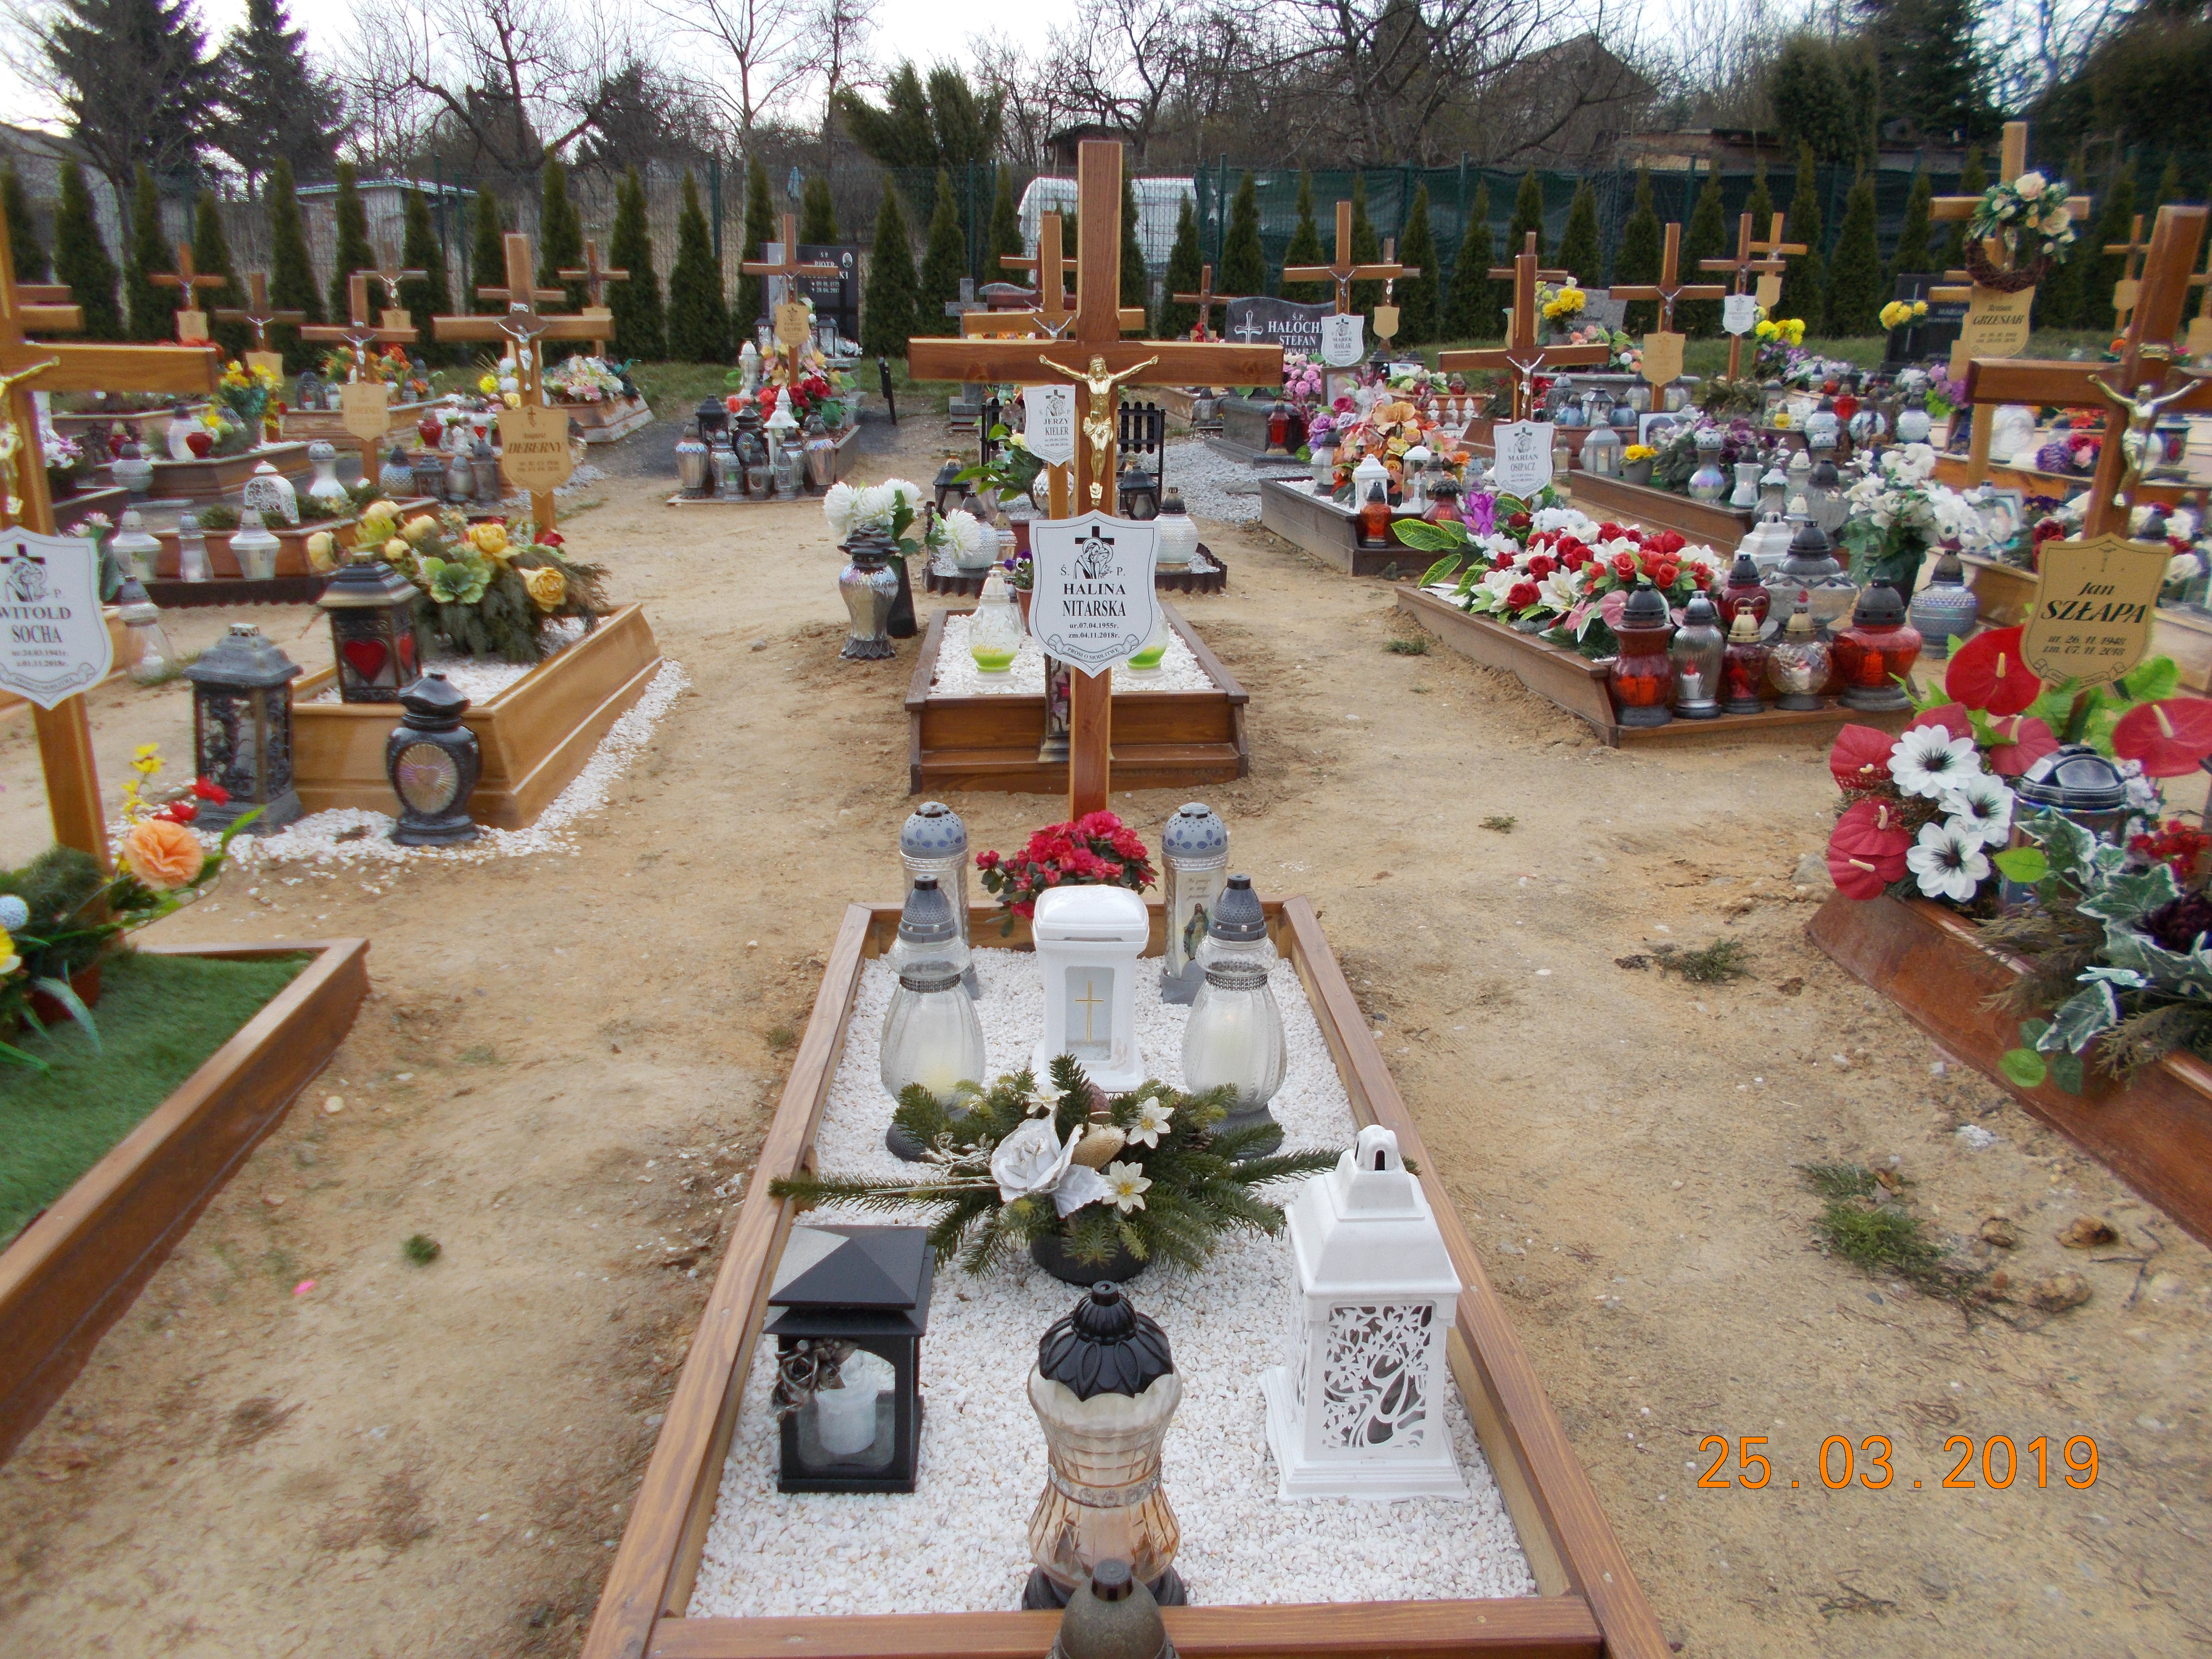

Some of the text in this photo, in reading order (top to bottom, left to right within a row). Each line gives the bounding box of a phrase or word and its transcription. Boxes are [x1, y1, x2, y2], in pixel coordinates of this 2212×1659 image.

[1279, 335, 1316, 345] STEFAN
[1045, 426, 1069, 436] KIELER
[1060, 564, 1126, 576] Ś. P.
[1063, 583, 1127, 595] HALINA
[2077, 581, 2115, 596] Jan
[0, 606, 72, 619] WITOLD
[1062, 600, 1127, 617] NITARSKA
[2040, 600, 2148, 624] SZŁAPA
[11, 625, 63, 643] SOCHA
[2101, 637, 2127, 645] 1948
[1067, 647, 1083, 658] PROSI
[1089, 648, 1119, 660] MODLITWĘ
[2099, 647, 2126, 656] 2018
